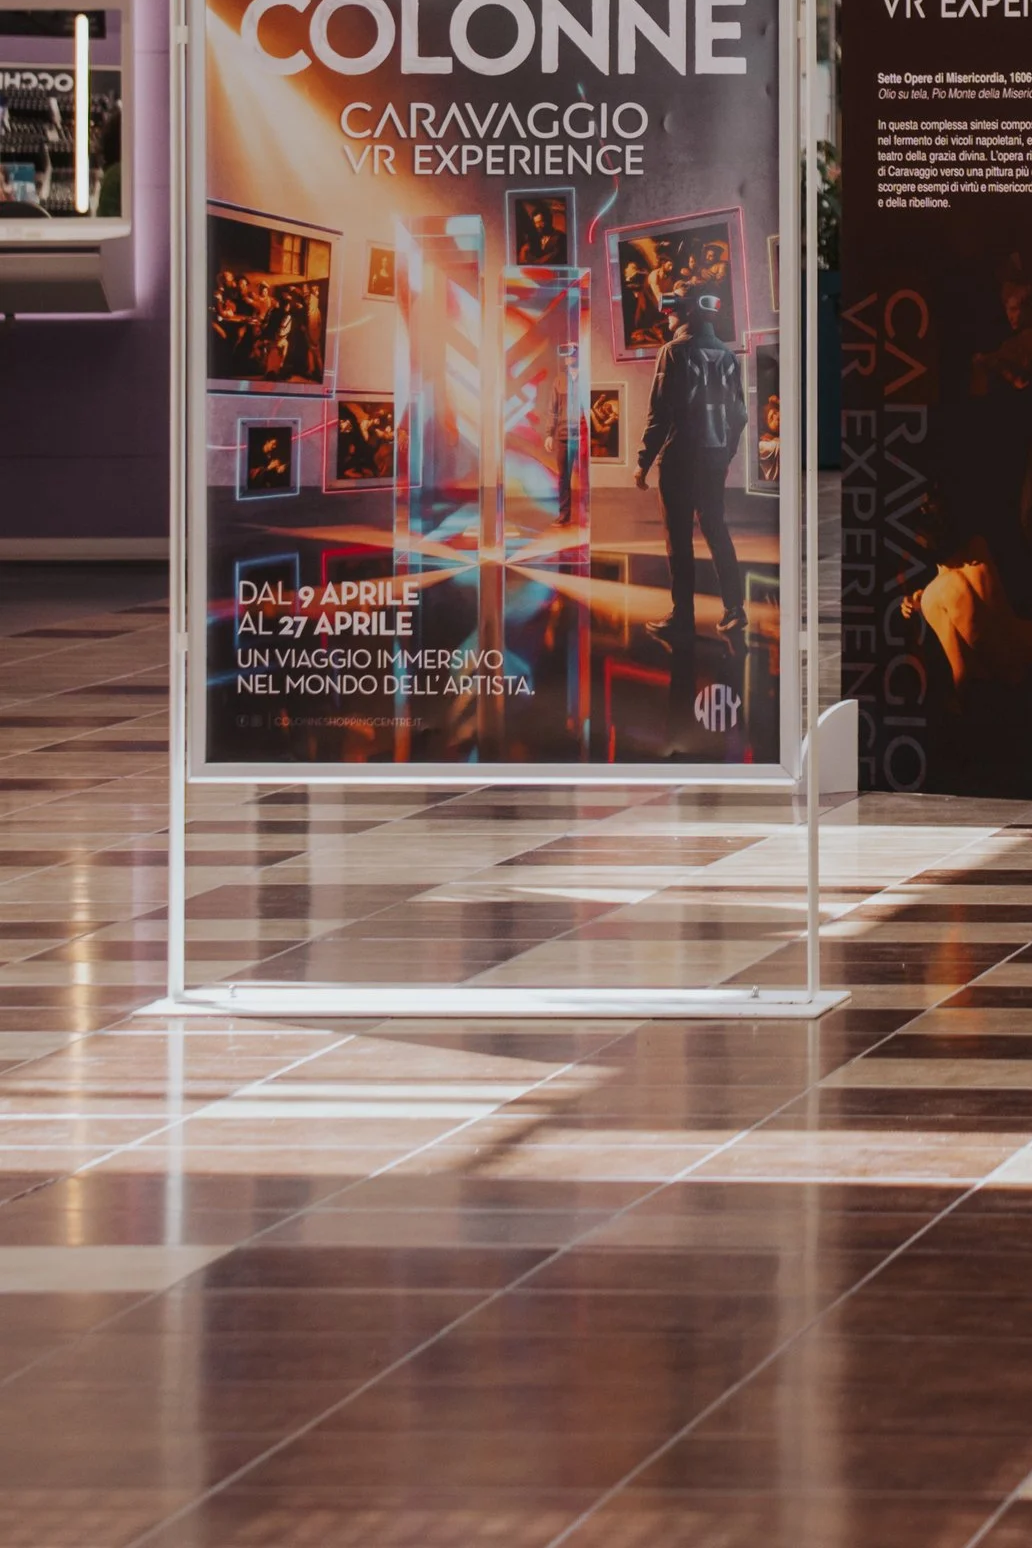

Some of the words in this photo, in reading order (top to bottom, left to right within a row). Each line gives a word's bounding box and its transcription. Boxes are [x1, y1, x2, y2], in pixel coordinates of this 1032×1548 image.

[878, 72, 902, 84] Sette
[904, 72, 933, 86] Opere
[946, 72, 1007, 85] Misericordia,
[878, 88, 897, 100] Olio
[898, 91, 909, 100] su
[911, 88, 929, 100] tela,
[932, 88, 947, 99] Pio
[948, 88, 977, 99] Monte
[978, 88, 1000, 99] della
[341, 103, 648, 139] CARAVAGGIO
[878, 120, 887, 130] In
[888, 120, 919, 133] questa
[920, 119, 968, 133] complessa
[970, 119, 999, 130] sintesi
[878, 135, 892, 146] nel
[894, 135, 933, 146] fermento
[934, 135, 949, 146] dei
[950, 135, 973, 146] vicoli
[976, 134, 1024, 148] napoletani,
[345, 144, 395, 176] VR
[414, 144, 644, 176] EXPERIENCE
[878, 151, 903, 161] teatro
[905, 150, 927, 161] della
[929, 150, 957, 164] grazia
[958, 150, 988, 162] divina.
[888, 165, 938, 180] Caravaggio
[940, 168, 965, 177] verso
[966, 168, 984, 177] una
[986, 166, 1014, 179] pittura
[1016, 166, 1029, 179] più
[878, 183, 916, 195] scorgere
[917, 182, 950, 195] esempi
[960, 181, 979, 193] virtù
[886, 197, 907, 208] della
[909, 197, 951, 208] ribellione.
[842, 292, 878, 379] VR
[883, 289, 929, 793] CARAVAGGIO
[238, 581, 292, 605] DAL
[299, 586, 315, 608] 9
[320, 581, 419, 605] APRILE
[238, 612, 273, 635] AL
[278, 616, 307, 639] 27
[313, 612, 413, 636] APRILE
[237, 649, 269, 669] UN
[275, 649, 372, 669] VIAGGIO
[377, 649, 504, 669] IMMERSIVO
[237, 675, 280, 695] NEL
[285, 675, 378, 695] MONDO
[694, 683, 742, 732] WAY
